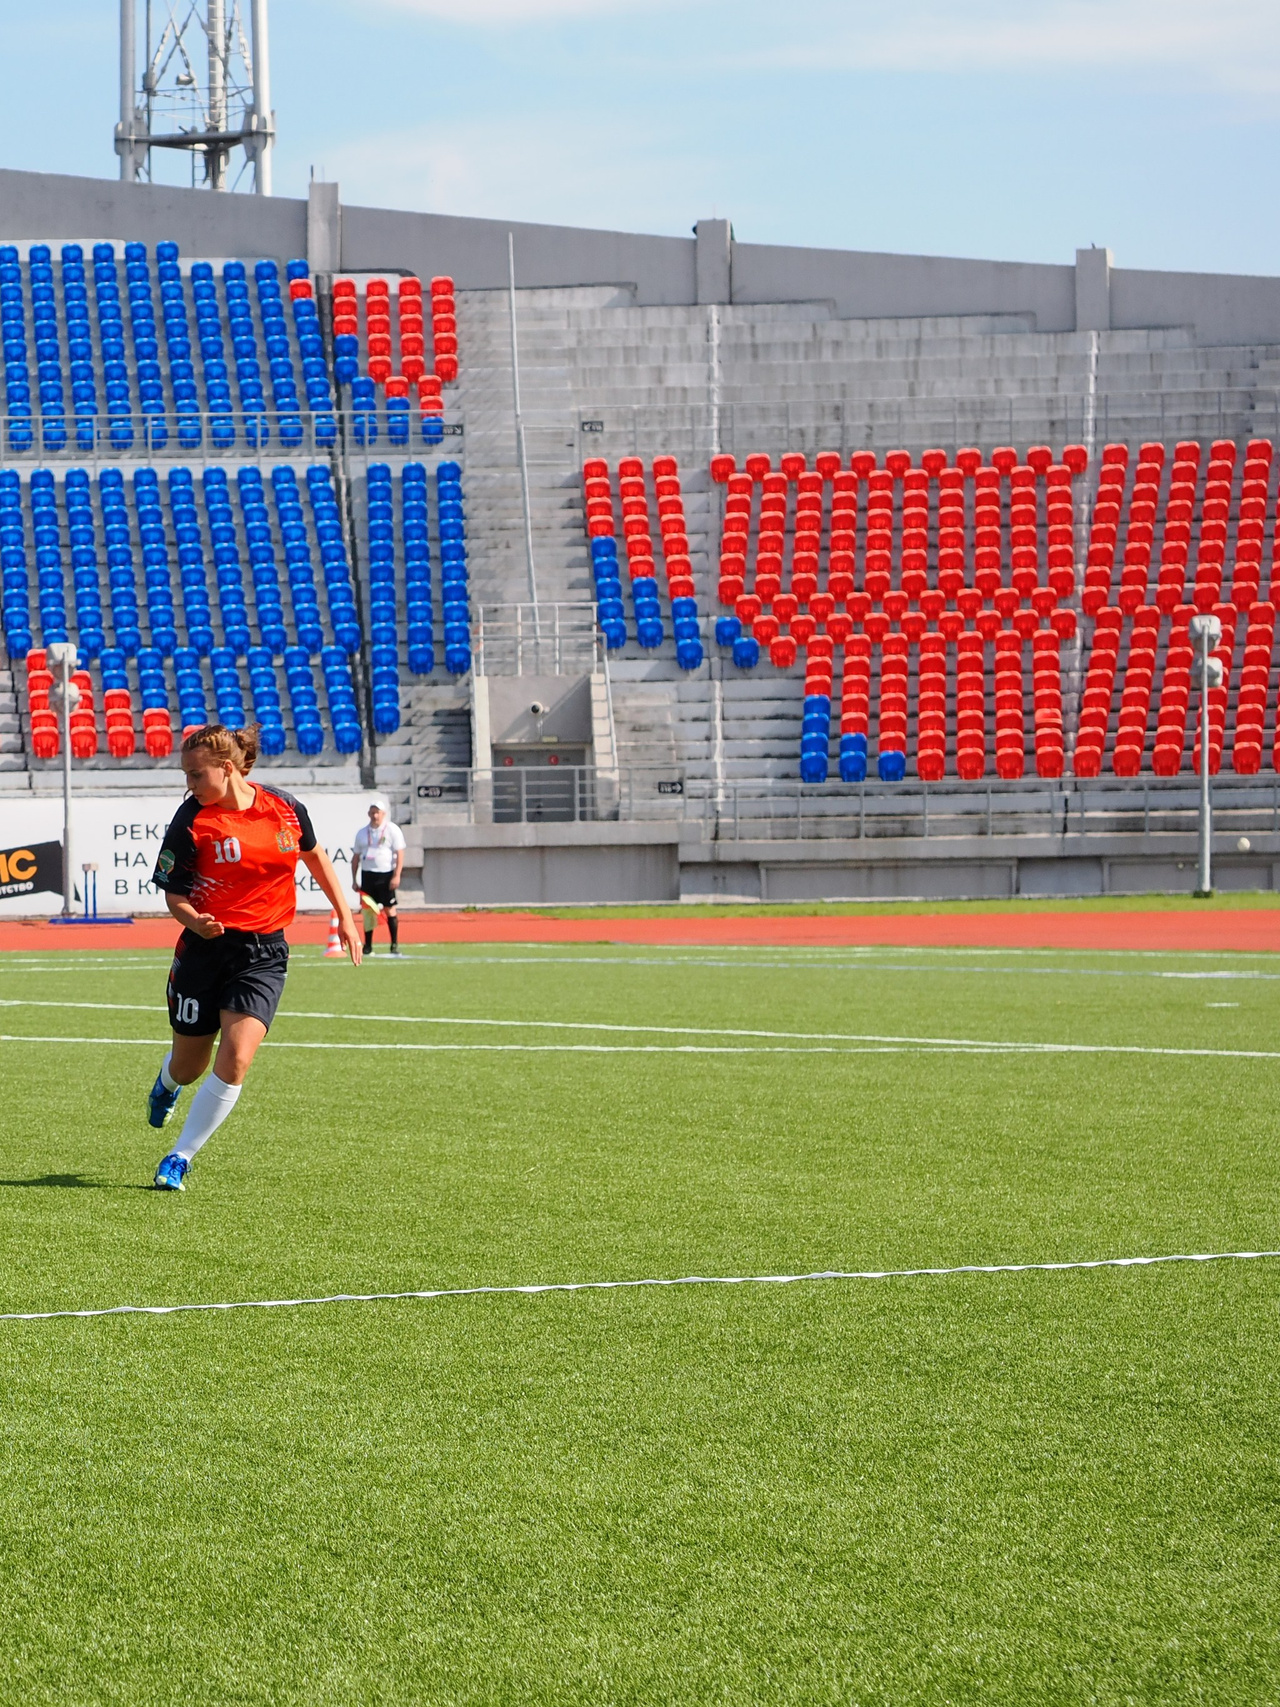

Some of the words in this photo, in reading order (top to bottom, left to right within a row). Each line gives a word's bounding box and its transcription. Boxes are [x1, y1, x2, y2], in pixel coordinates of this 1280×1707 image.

[114, 851, 148, 867] НА
[211, 836, 242, 864] 10
[115, 879, 129, 895] В
[176, 992, 199, 1025] 10
